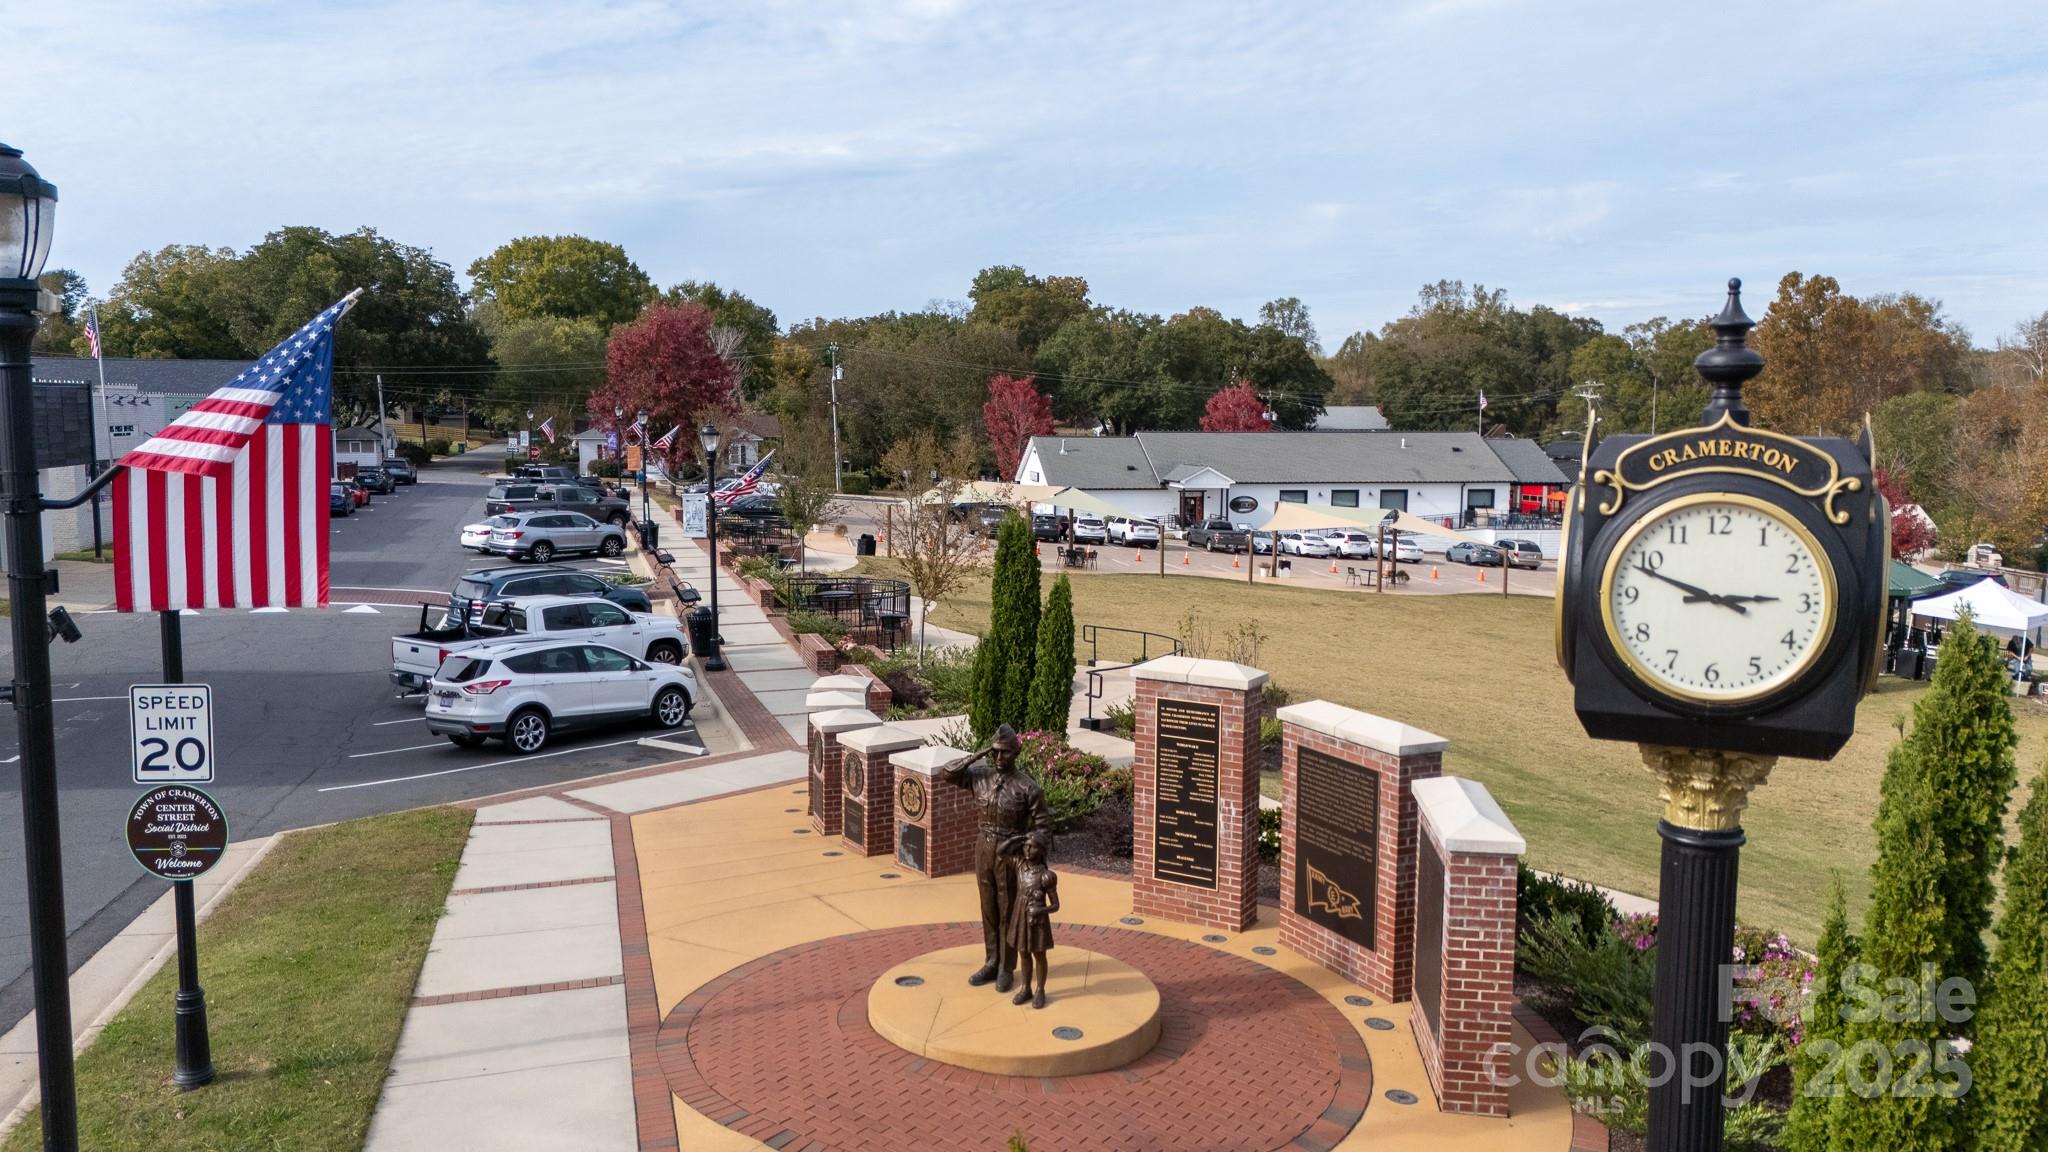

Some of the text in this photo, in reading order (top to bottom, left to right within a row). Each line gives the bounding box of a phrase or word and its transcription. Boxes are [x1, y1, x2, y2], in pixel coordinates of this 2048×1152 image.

[1649, 439, 1799, 474] CRAMERTON
[1668, 525, 1688, 544] 11
[1708, 515, 1733, 535] 12
[1760, 527, 1769, 547] 1
[1639, 550, 1664, 571] 10
[1786, 554, 1800, 574] 2
[1624, 586, 1639, 604] 9
[1797, 593, 1811, 614] 3
[1635, 622, 1650, 642] 8
[1781, 629, 1797, 650] 4
[1666, 649, 1679, 670] 7
[1749, 656, 1762, 676] 5
[1704, 662, 1720, 682] 6
[138, 696, 204, 710] SPEED
[146, 716, 197, 730] LIMIT
[140, 737, 206, 772] 20
[134, 789, 220, 820] TOWN OF CRAMERTON
[155, 804, 196, 812] CENTER
[156, 813, 196, 821] STREET
[144, 822, 210, 834] Social District
[154, 857, 203, 870] Welcome
